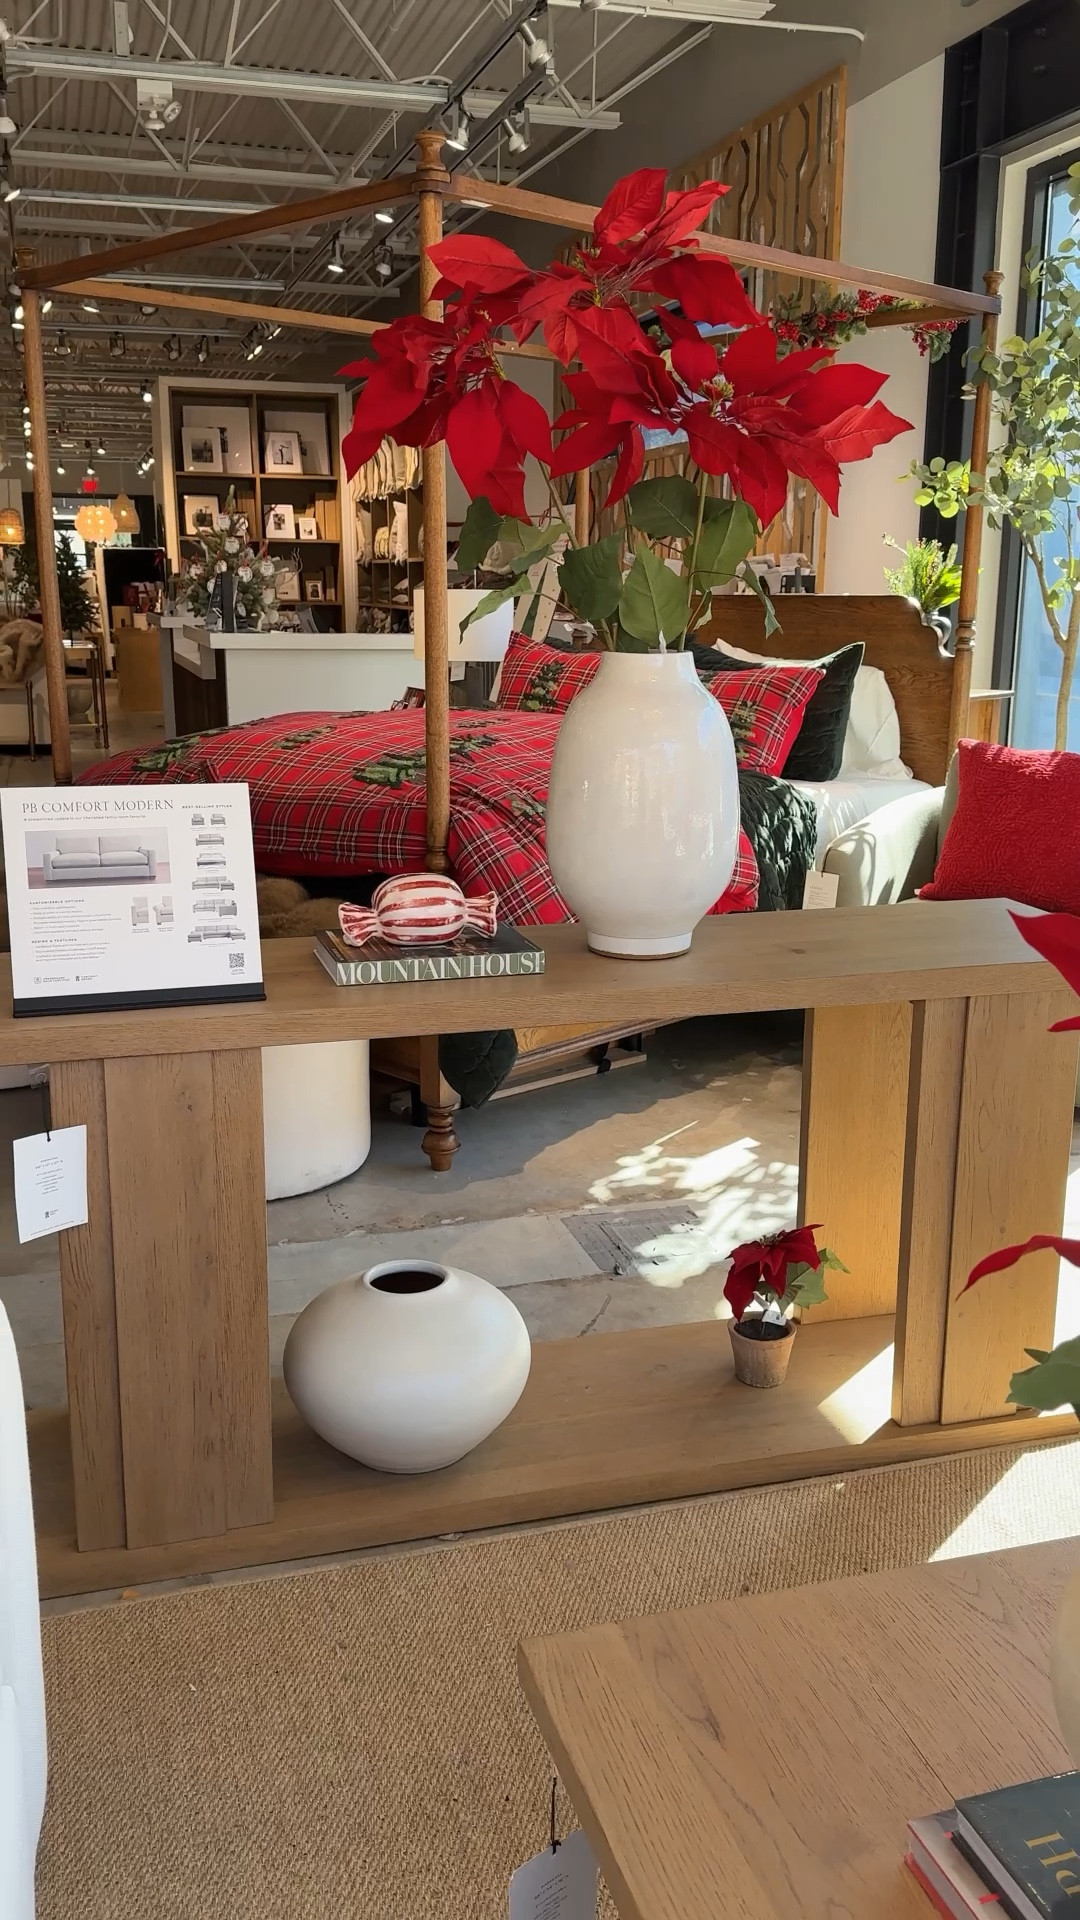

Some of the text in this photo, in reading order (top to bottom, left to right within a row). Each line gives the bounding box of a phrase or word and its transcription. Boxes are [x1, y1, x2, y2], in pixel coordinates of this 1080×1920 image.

[22, 799, 174, 814] PB COMFORT MODERN
[337, 951, 545, 985] MOUNTAIN HOUSE
